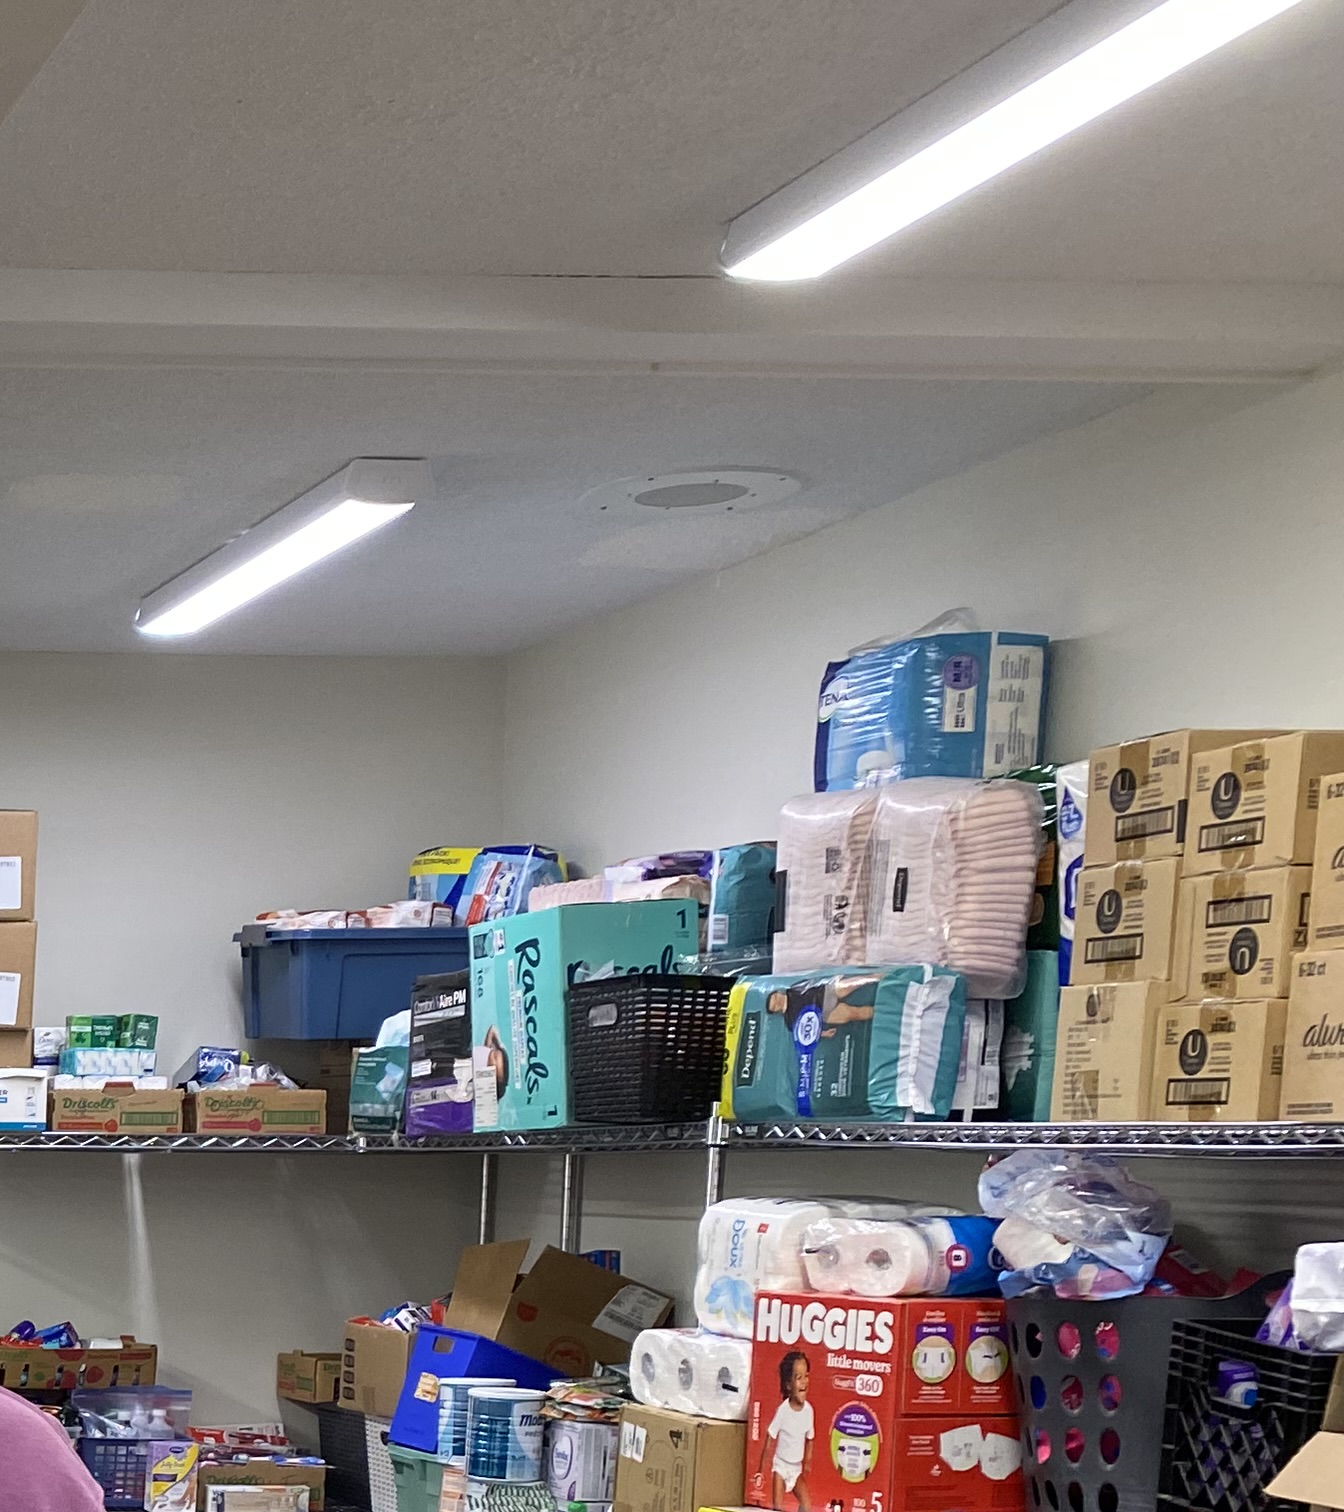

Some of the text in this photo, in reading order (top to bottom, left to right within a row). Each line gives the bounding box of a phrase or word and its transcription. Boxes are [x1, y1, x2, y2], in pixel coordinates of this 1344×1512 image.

[820, 692, 850, 708] TENA
[676, 908, 687, 929] 1
[514, 938, 549, 1096] Rascals
[740, 1018, 757, 1079] Depend
[756, 1297, 895, 1354] HUGGIES
[826, 1353, 892, 1374] little movers
[857, 1376, 880, 1393] 360
[669, 1429, 682, 1449] 4
